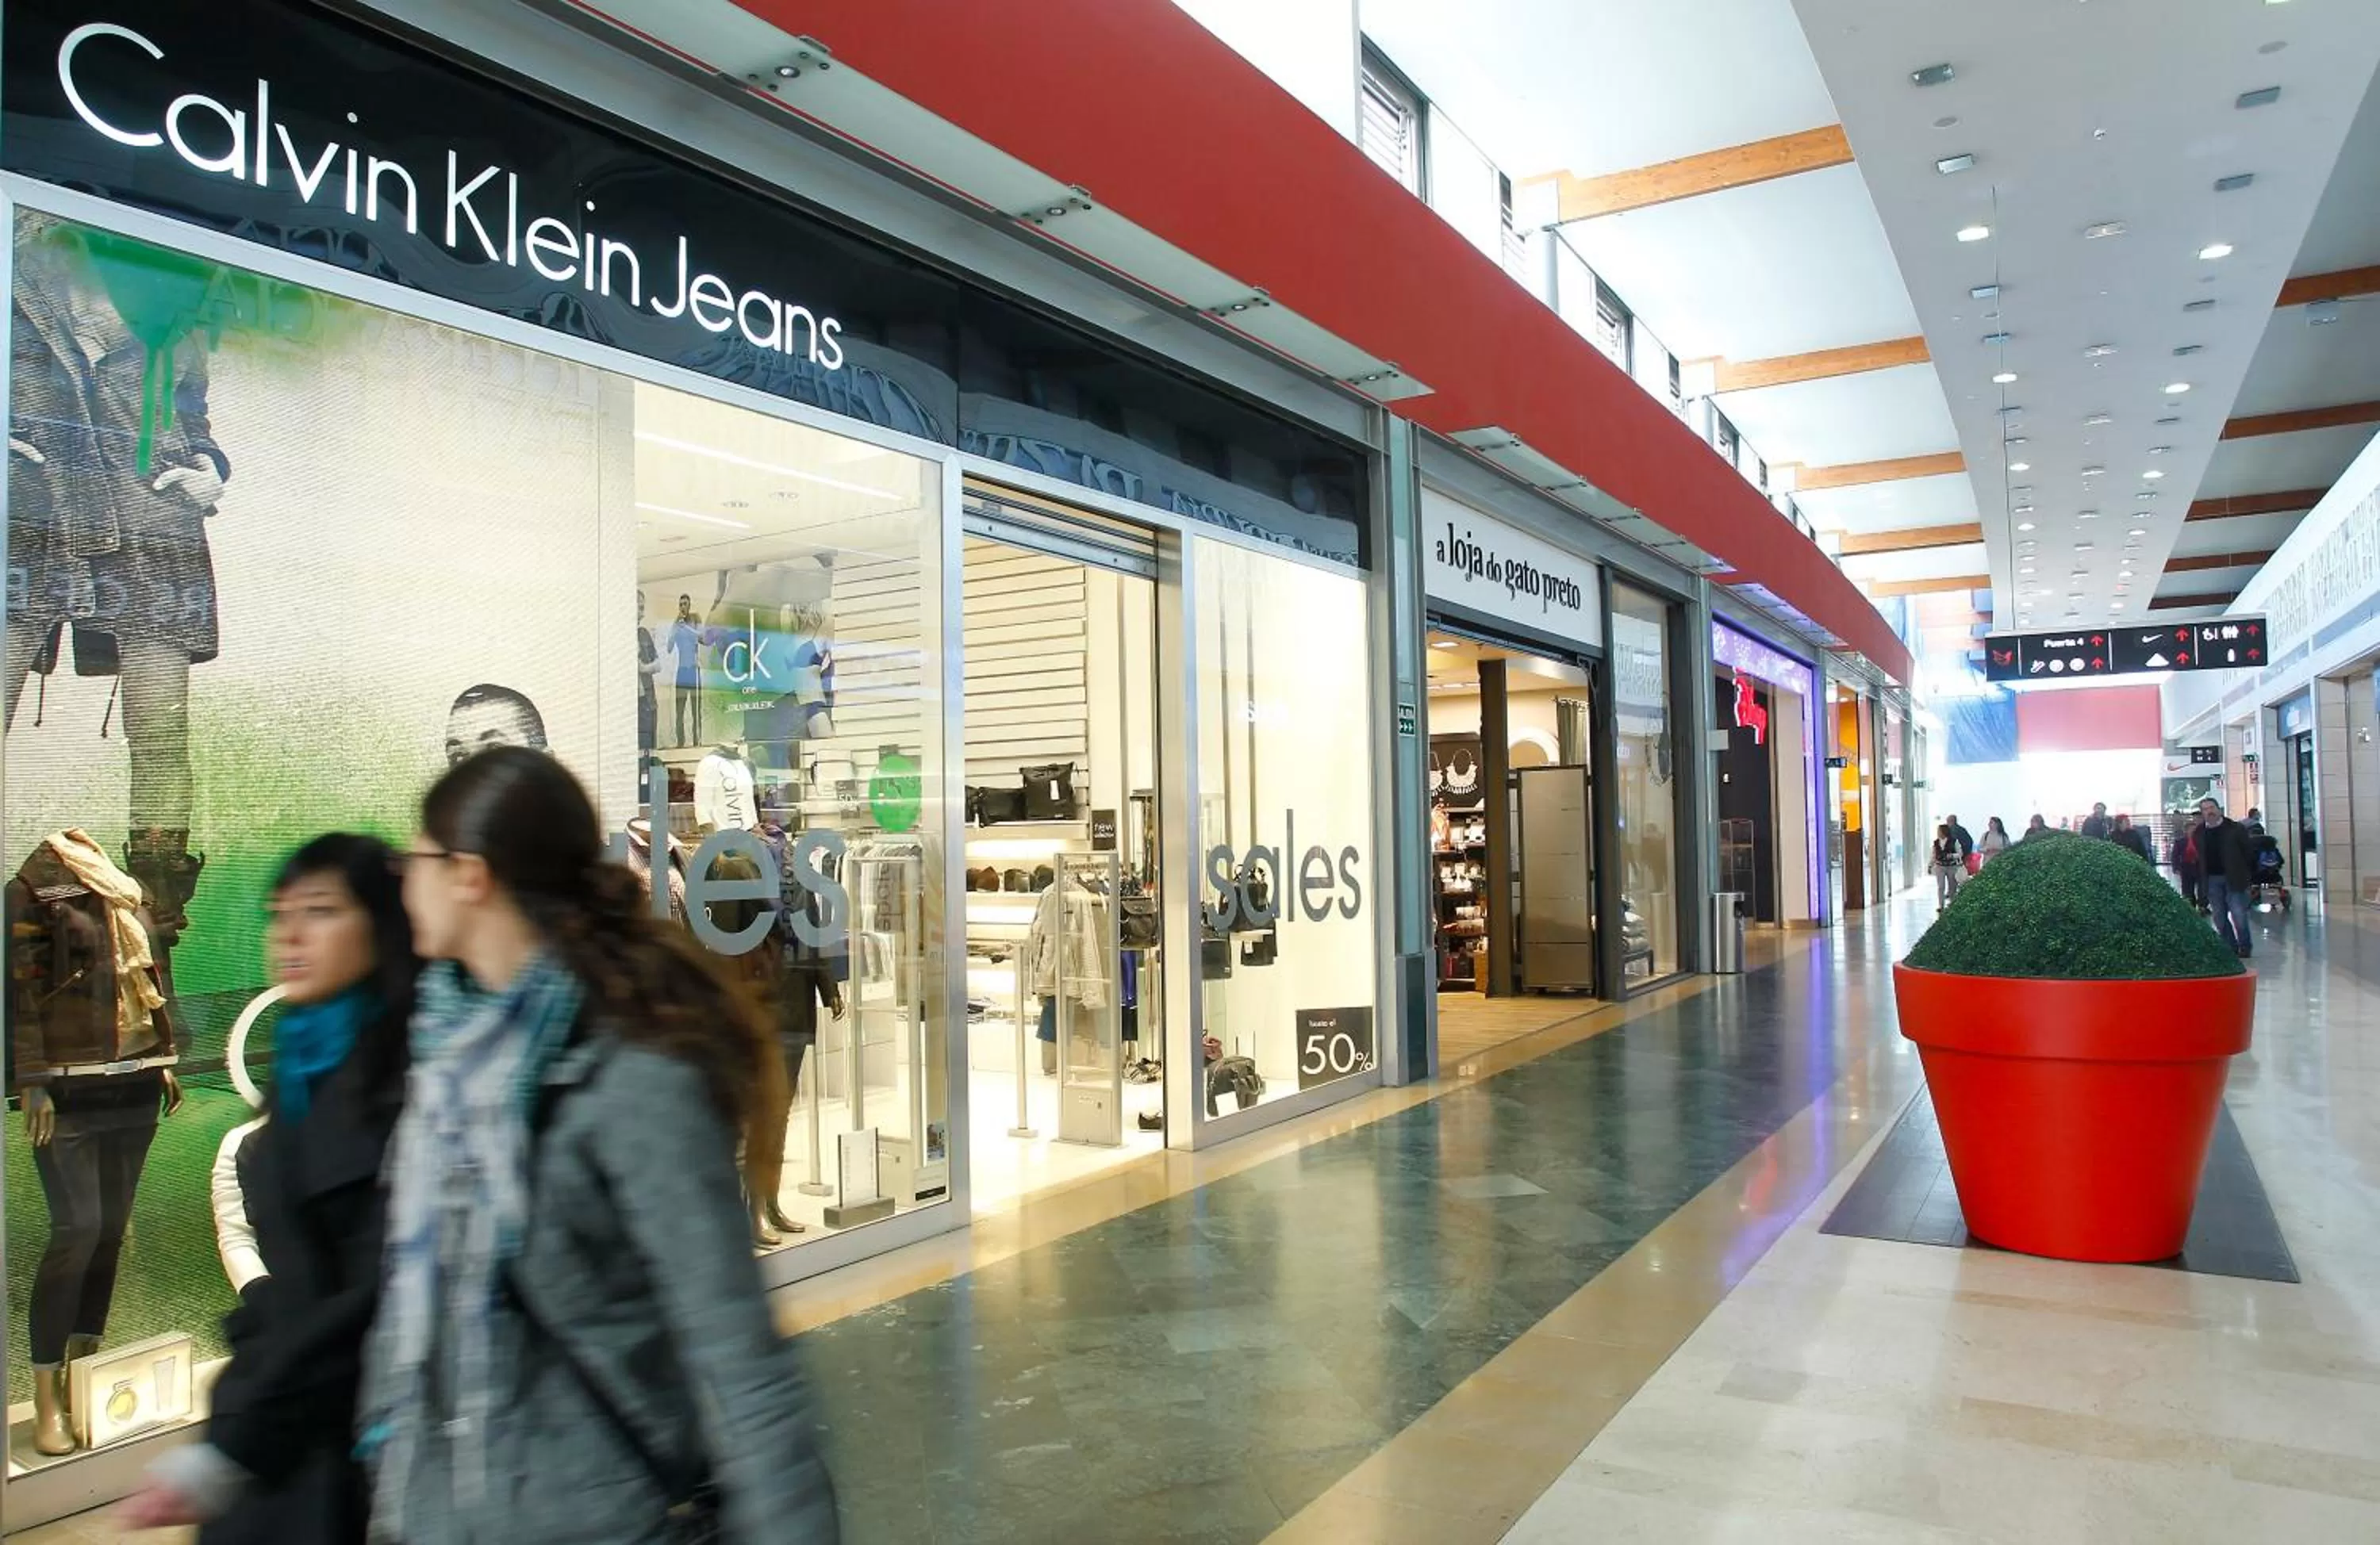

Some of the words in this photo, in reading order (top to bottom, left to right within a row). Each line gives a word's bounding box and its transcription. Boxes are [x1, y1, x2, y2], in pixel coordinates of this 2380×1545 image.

[58, 22, 417, 234] Calvin
[446, 149, 641, 307] Klein
[650, 235, 843, 370] Jeans
[1437, 539, 1445, 562] a
[1447, 523, 1484, 582] loja
[1486, 552, 1502, 583] do
[1505, 558, 1541, 600] gato
[1542, 573, 1581, 614] preto
[723, 608, 772, 683] ck
[601, 765, 850, 956] les
[1205, 808, 1361, 933] sales
[1302, 1032, 1373, 1075] 50%
